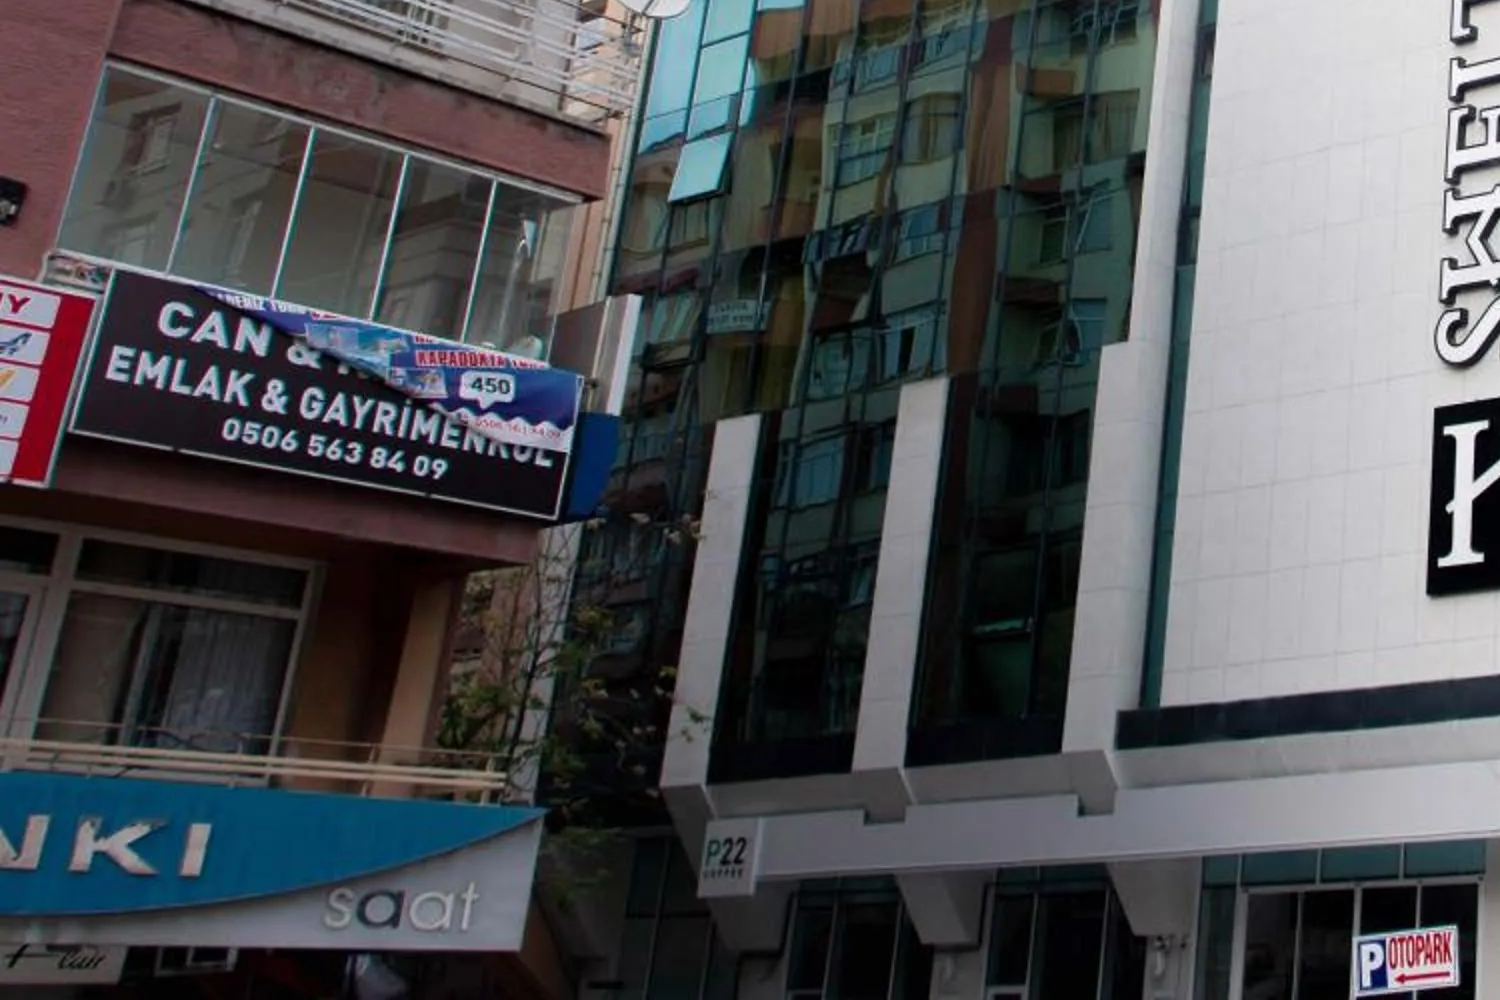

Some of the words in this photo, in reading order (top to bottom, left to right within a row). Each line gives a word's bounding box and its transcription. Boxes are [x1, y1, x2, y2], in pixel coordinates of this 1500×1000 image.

[158, 300, 273, 358] CAN
[105, 344, 256, 408] EMLAK
[261, 377, 290, 415] &
[471, 376, 511, 395] 450
[222, 416, 299, 453] 0506
[307, 433, 363, 465] 563
[370, 448, 407, 474] 84
[412, 454, 449, 481] 09
[704, 837, 747, 868] P22
[323, 881, 481, 932] saat
[1361, 944, 1385, 988] P
[1387, 931, 1453, 969] OTOPARK
